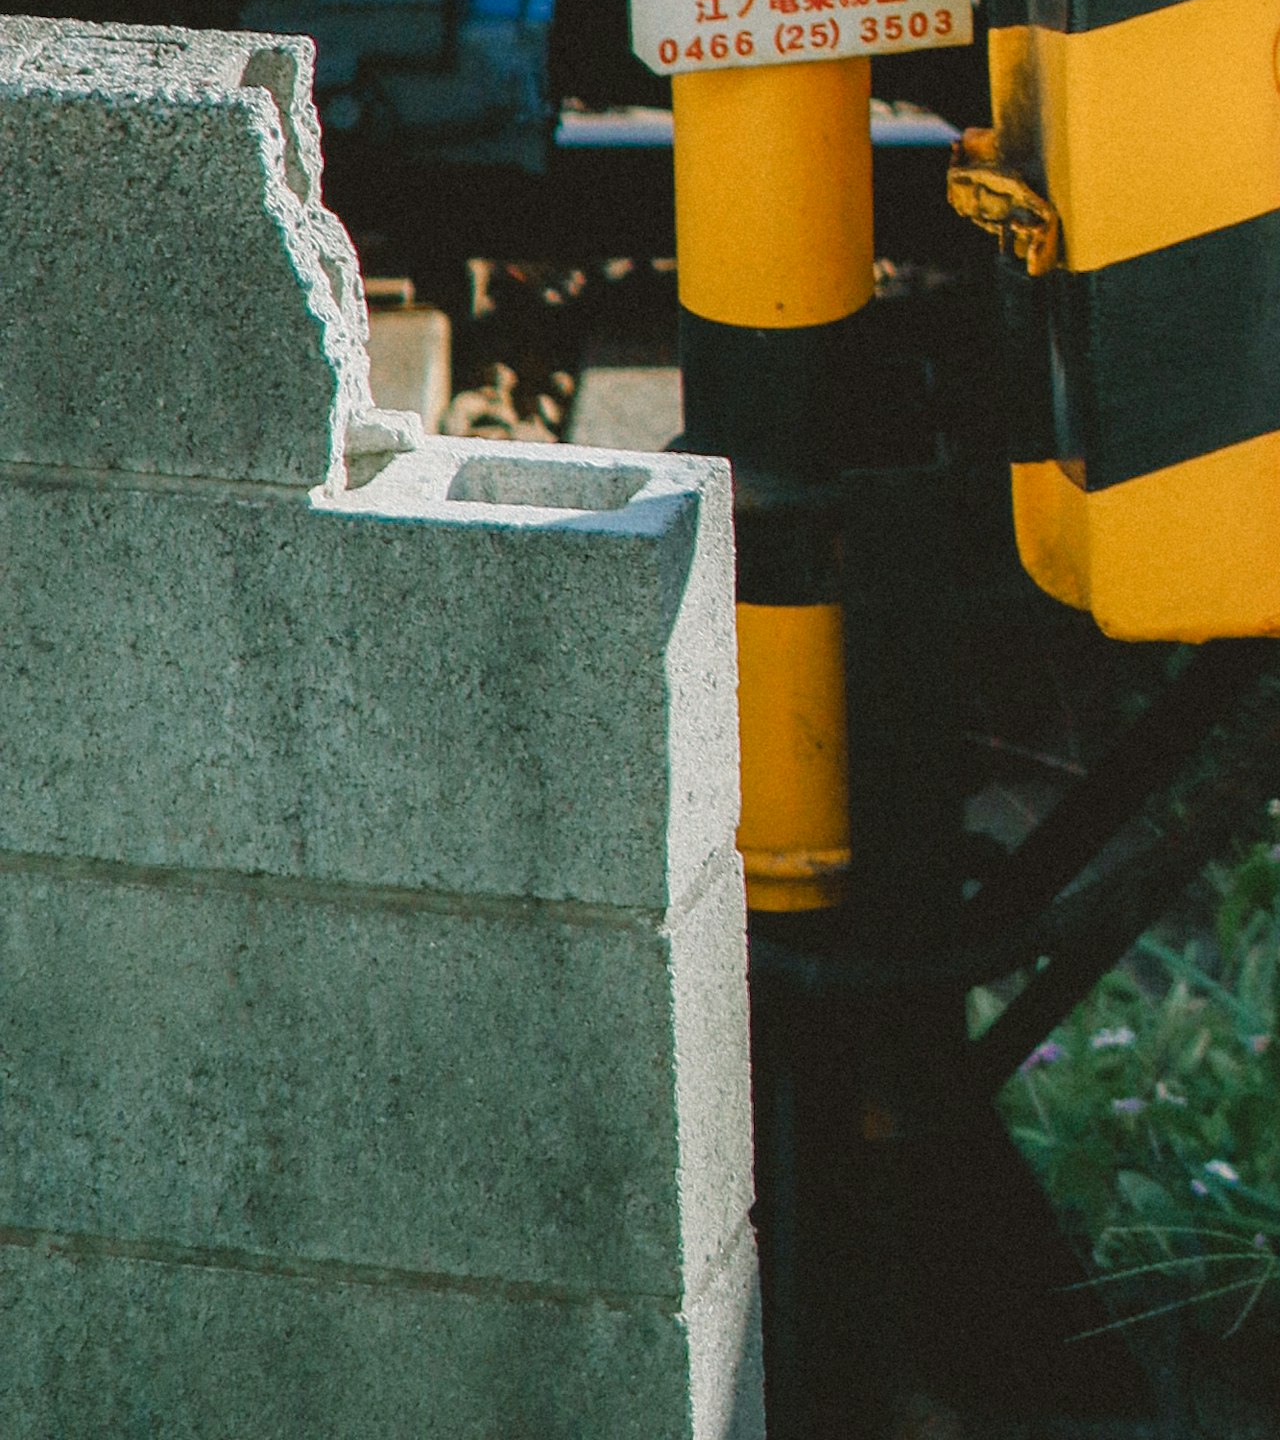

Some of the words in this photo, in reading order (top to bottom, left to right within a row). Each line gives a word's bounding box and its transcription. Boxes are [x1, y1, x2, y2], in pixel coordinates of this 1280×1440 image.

[658, 30, 754, 65] 0466
[773, 16, 840, 55] (25)
[859, 8, 953, 44] 3503
